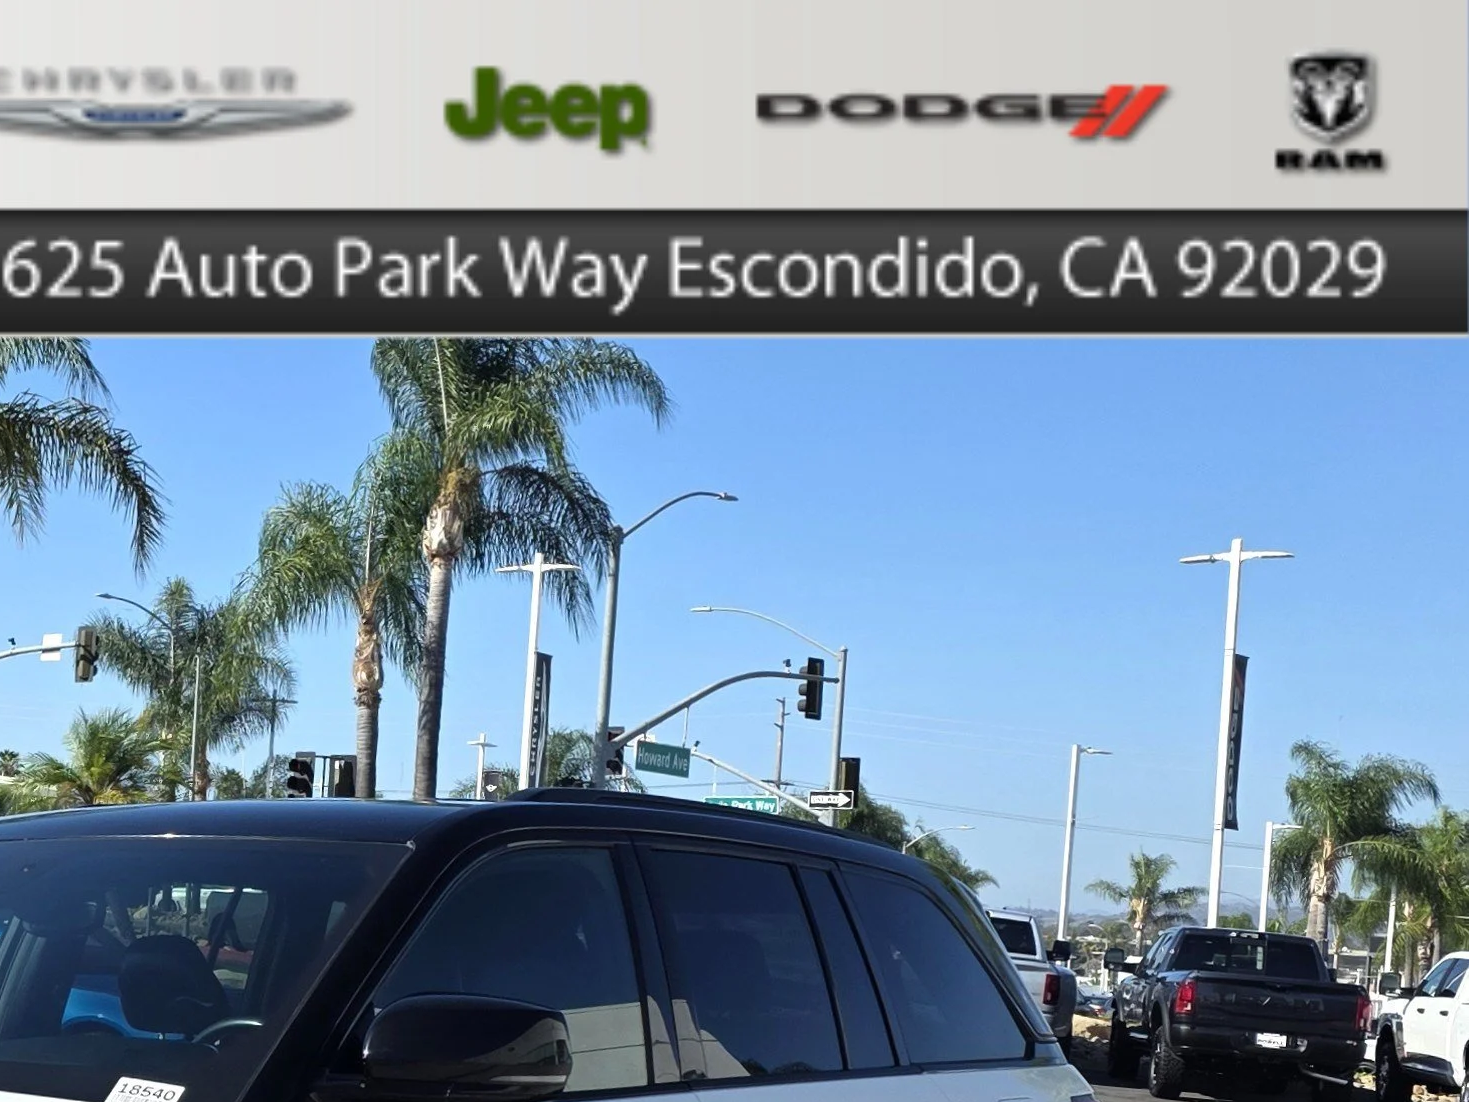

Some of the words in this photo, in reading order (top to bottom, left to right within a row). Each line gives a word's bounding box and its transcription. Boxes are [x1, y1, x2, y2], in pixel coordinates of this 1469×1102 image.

[529, 676, 541, 777] CHRYSLER
[637, 746, 671, 768] Howard
[672, 755, 689, 772] Ave
[755, 800, 776, 812] Way
[118, 1083, 176, 1101] 18540
